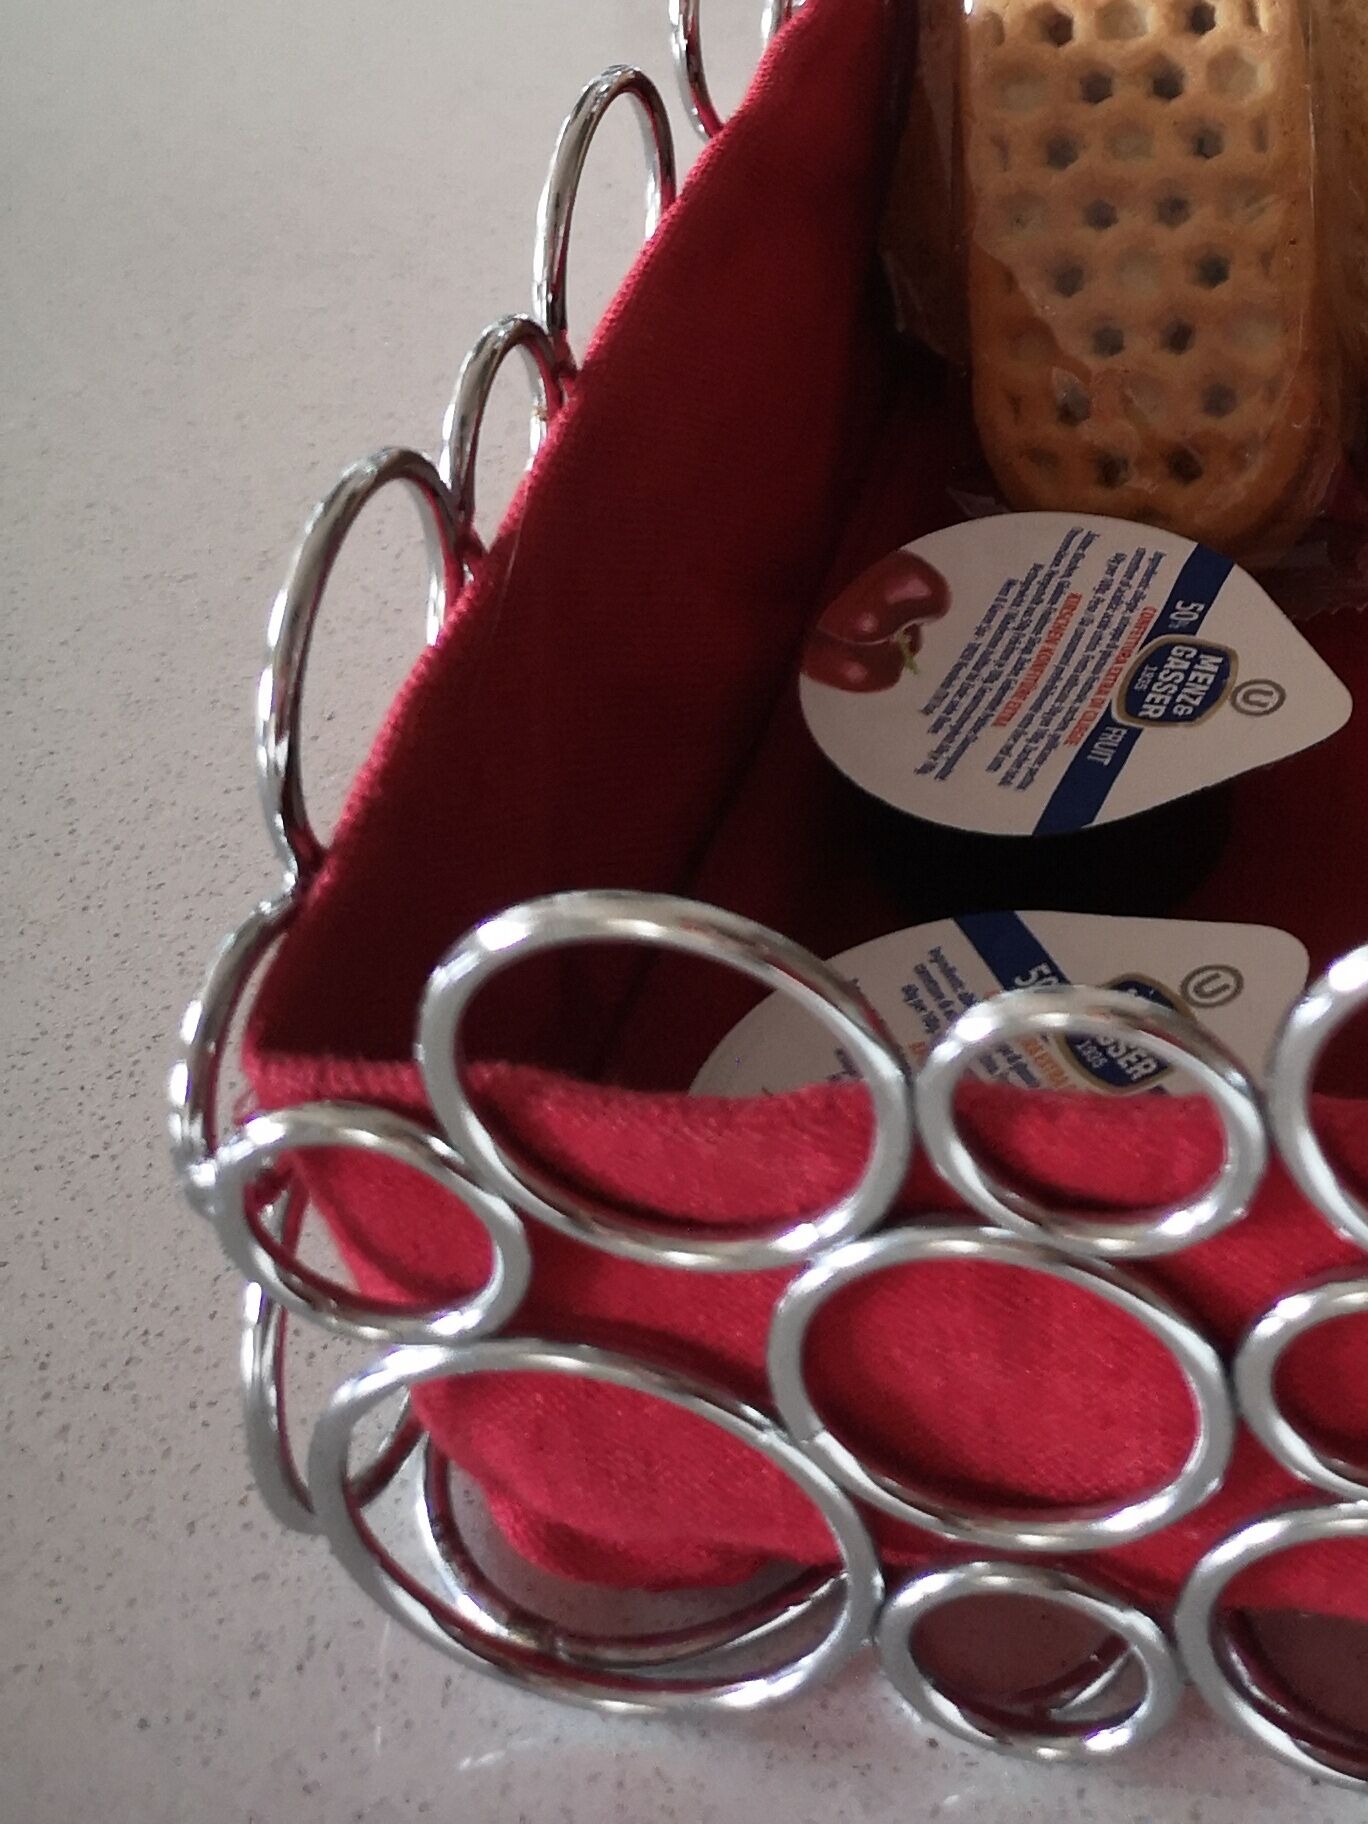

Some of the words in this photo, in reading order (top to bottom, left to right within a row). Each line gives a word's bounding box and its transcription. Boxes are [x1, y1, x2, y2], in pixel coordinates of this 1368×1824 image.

[1137, 645, 1198, 720] GASSER
[1172, 651, 1224, 717] MENZ&
[1086, 725, 1128, 767] FRUIT
